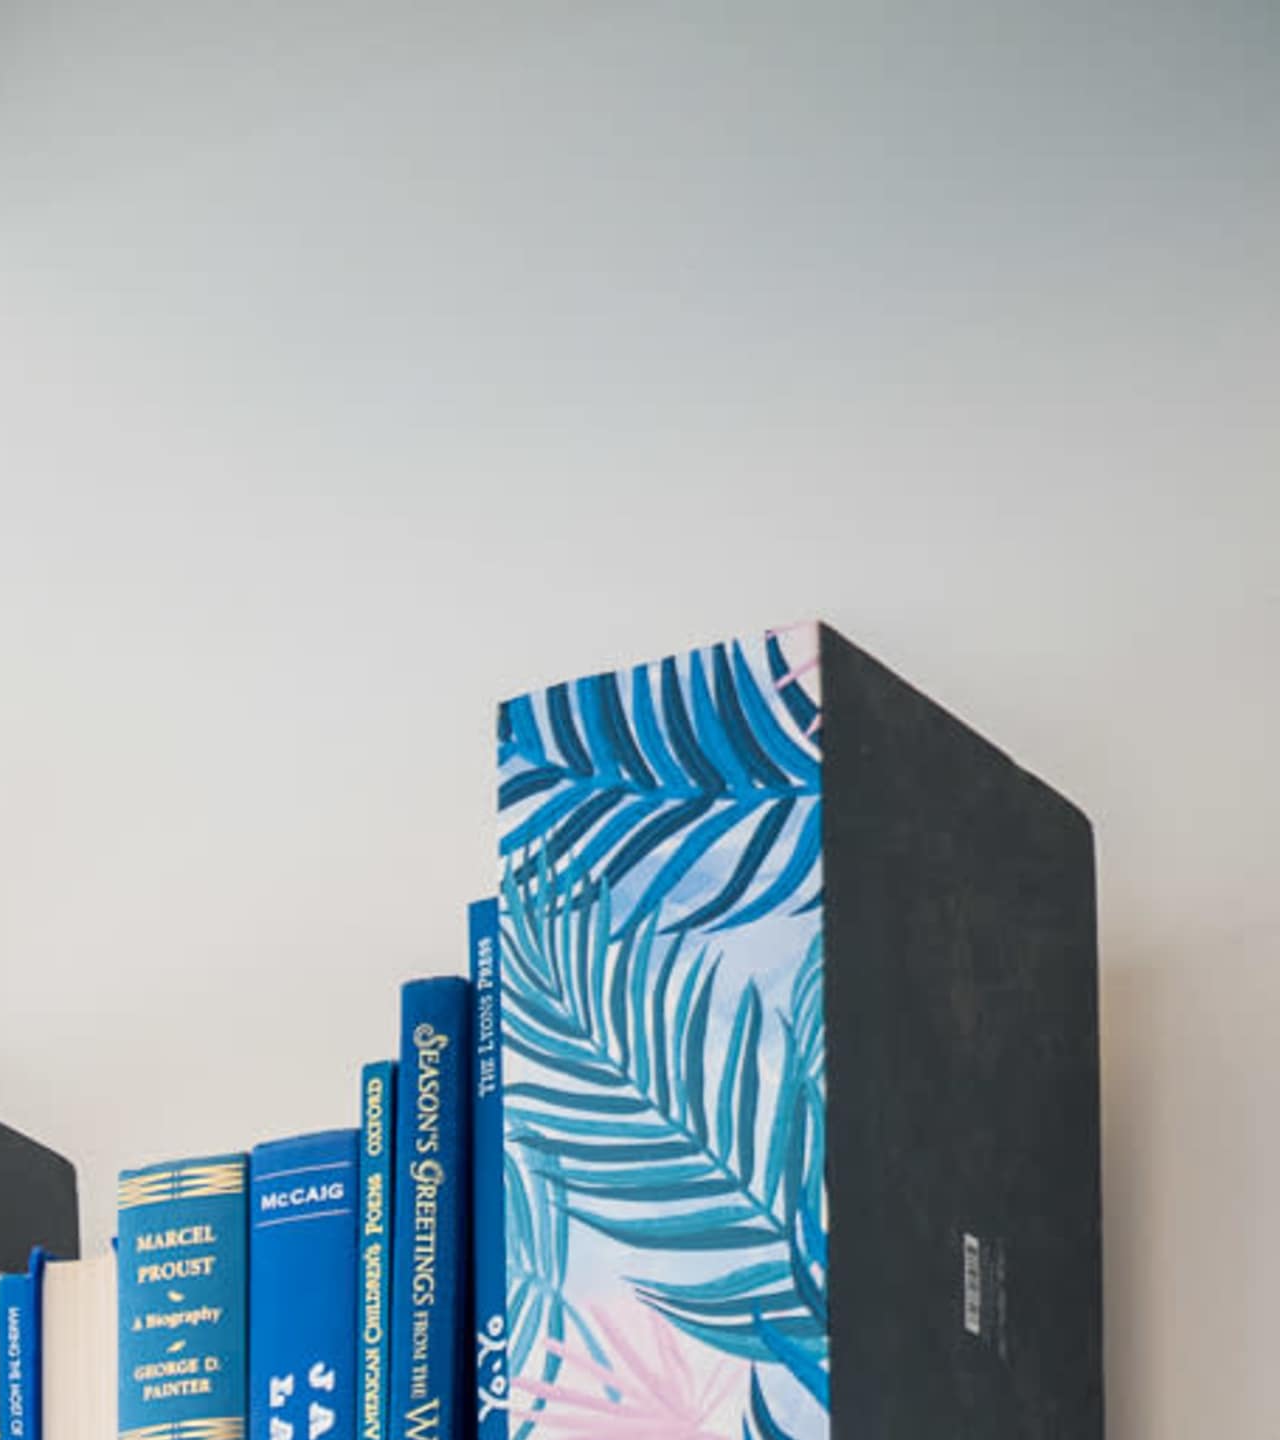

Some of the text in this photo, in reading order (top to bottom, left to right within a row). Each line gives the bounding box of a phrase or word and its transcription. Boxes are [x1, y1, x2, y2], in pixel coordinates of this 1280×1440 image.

[476, 935, 497, 1099] THE LYONS PRESS
[412, 1023, 449, 1154] SEASON'S
[365, 1077, 384, 1157] OXFORD
[260, 1183, 346, 1212] McCAIG
[364, 1172, 384, 1236] POEMS
[136, 1224, 216, 1253] MARCEL
[409, 1158, 446, 1306] GREETINGS
[137, 1256, 216, 1285] PROUST
[363, 1242, 383, 1345] CHILDREN'S
[7, 1307, 21, 1357] MAKING
[131, 1305, 223, 1331] A Biography
[412, 1311, 429, 1360] FROM
[8, 1360, 22, 1381] THE
[134, 1355, 221, 1382] GEORGE D.
[410, 1364, 429, 1400] THE
[476, 1314, 509, 1424] Yo-Yo
[10, 1383, 24, 1416] MOST
[143, 1378, 212, 1402] PAINTER
[11, 1421, 24, 1437] OF
